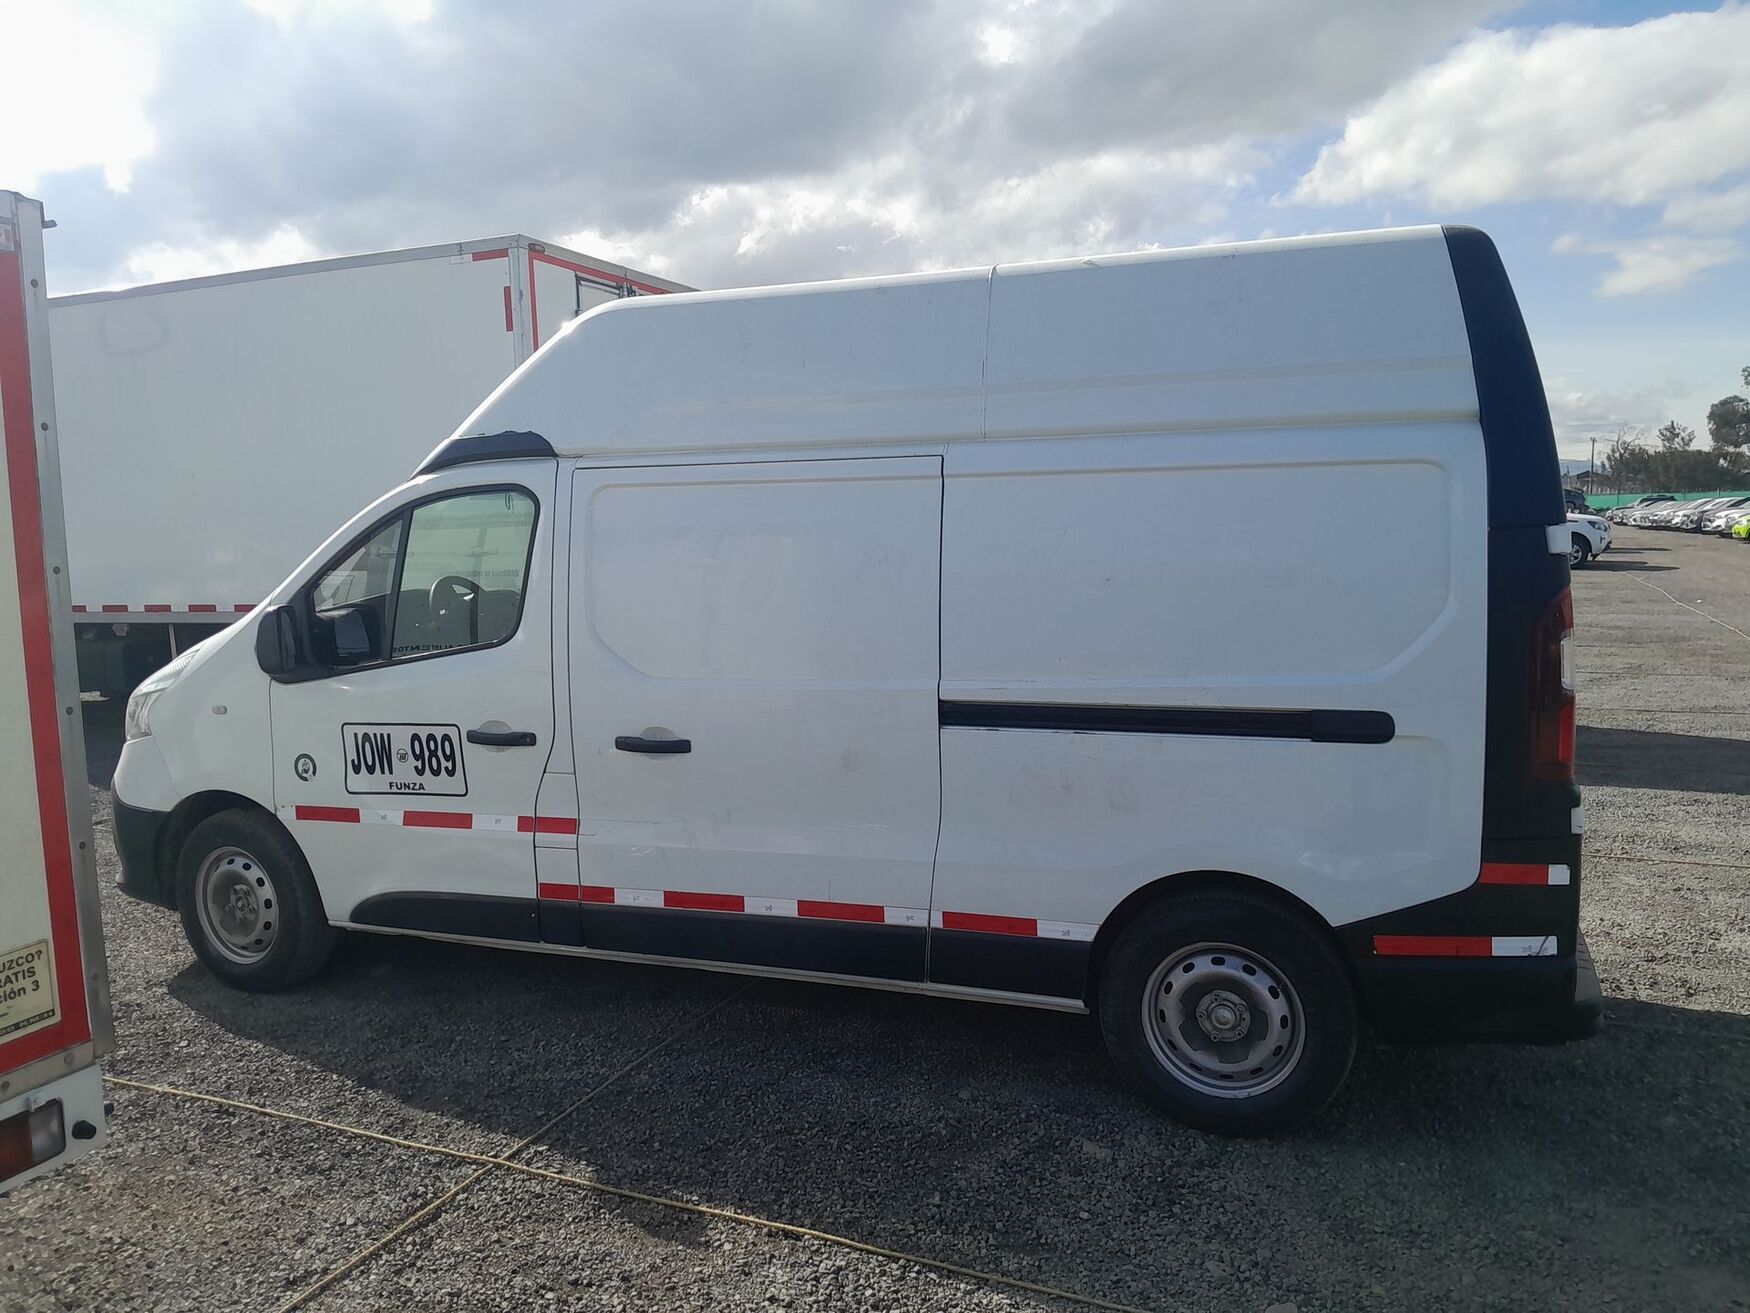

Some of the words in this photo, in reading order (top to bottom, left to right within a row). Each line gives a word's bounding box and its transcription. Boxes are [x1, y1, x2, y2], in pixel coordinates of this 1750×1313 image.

[351, 732, 394, 775] JOW
[410, 732, 457, 777] 989
[389, 781, 425, 791] FUNZA
[31, 979, 40, 992] 3
